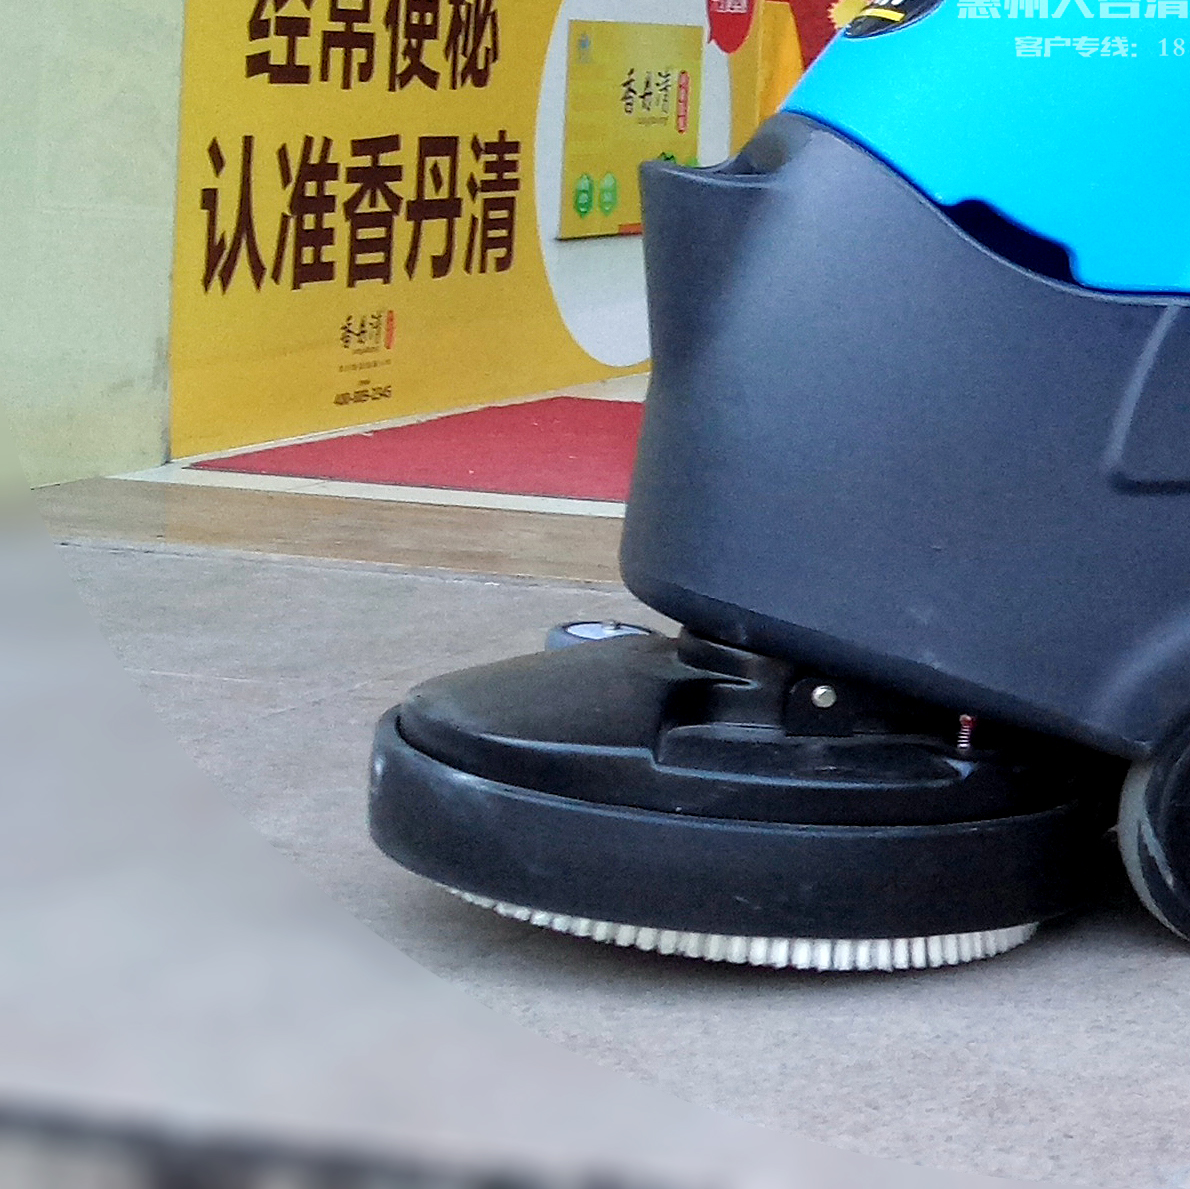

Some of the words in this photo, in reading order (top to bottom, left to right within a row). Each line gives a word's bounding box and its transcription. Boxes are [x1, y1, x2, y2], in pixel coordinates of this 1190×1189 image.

[200, 129, 522, 296] 认准香丹清
